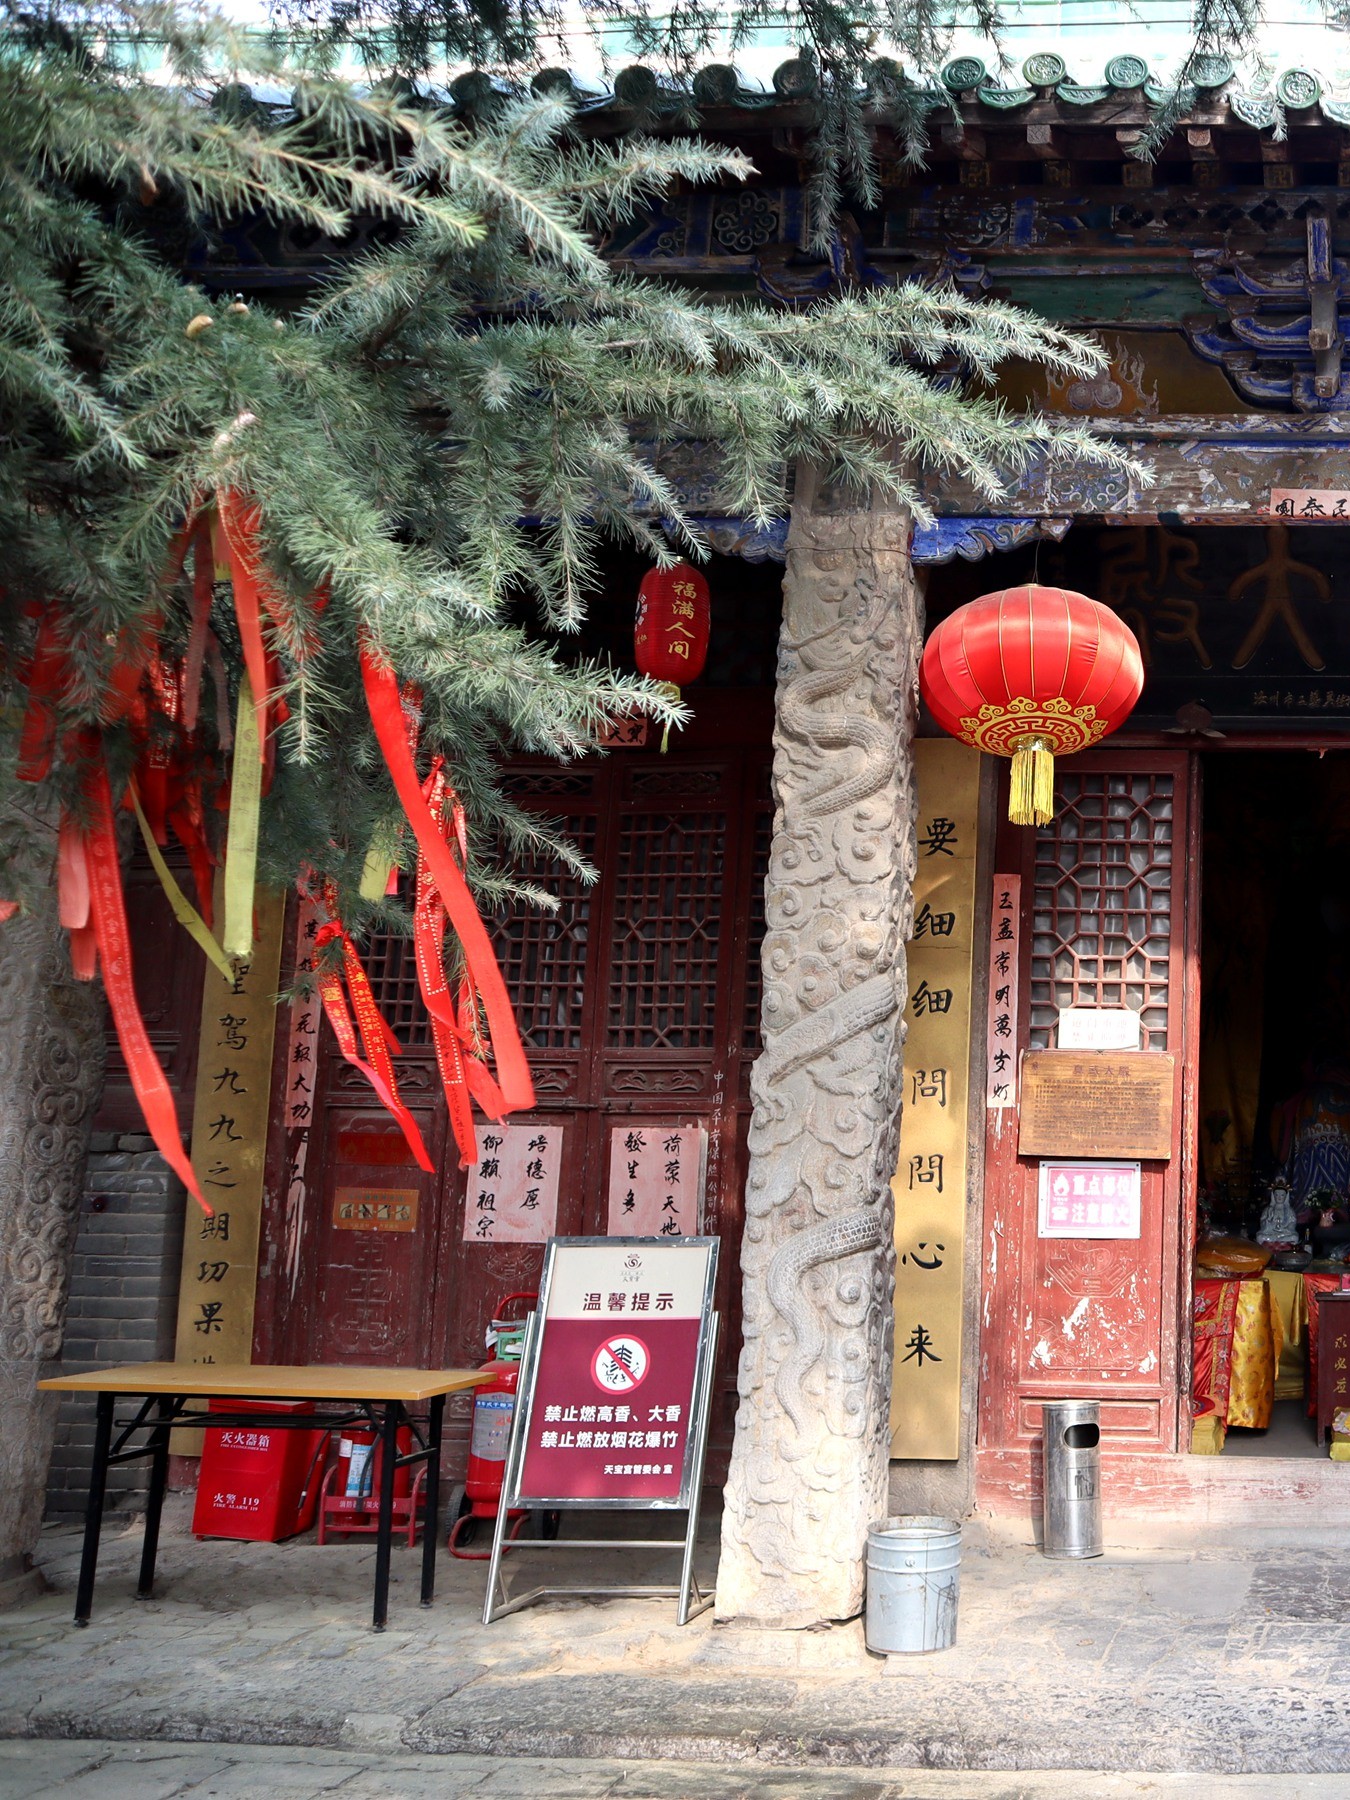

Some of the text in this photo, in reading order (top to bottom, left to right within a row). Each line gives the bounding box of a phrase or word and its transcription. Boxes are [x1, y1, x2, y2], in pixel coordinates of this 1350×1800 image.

[583, 1292, 675, 1312] 温馨提示
[544, 1404, 683, 1423] 禁止燃高香、大香
[221, 1431, 271, 1448] 灭火器箱
[540, 1430, 679, 1449] 禁止燃放烟花爆竹
[213, 1493, 260, 1507] 火警 119
